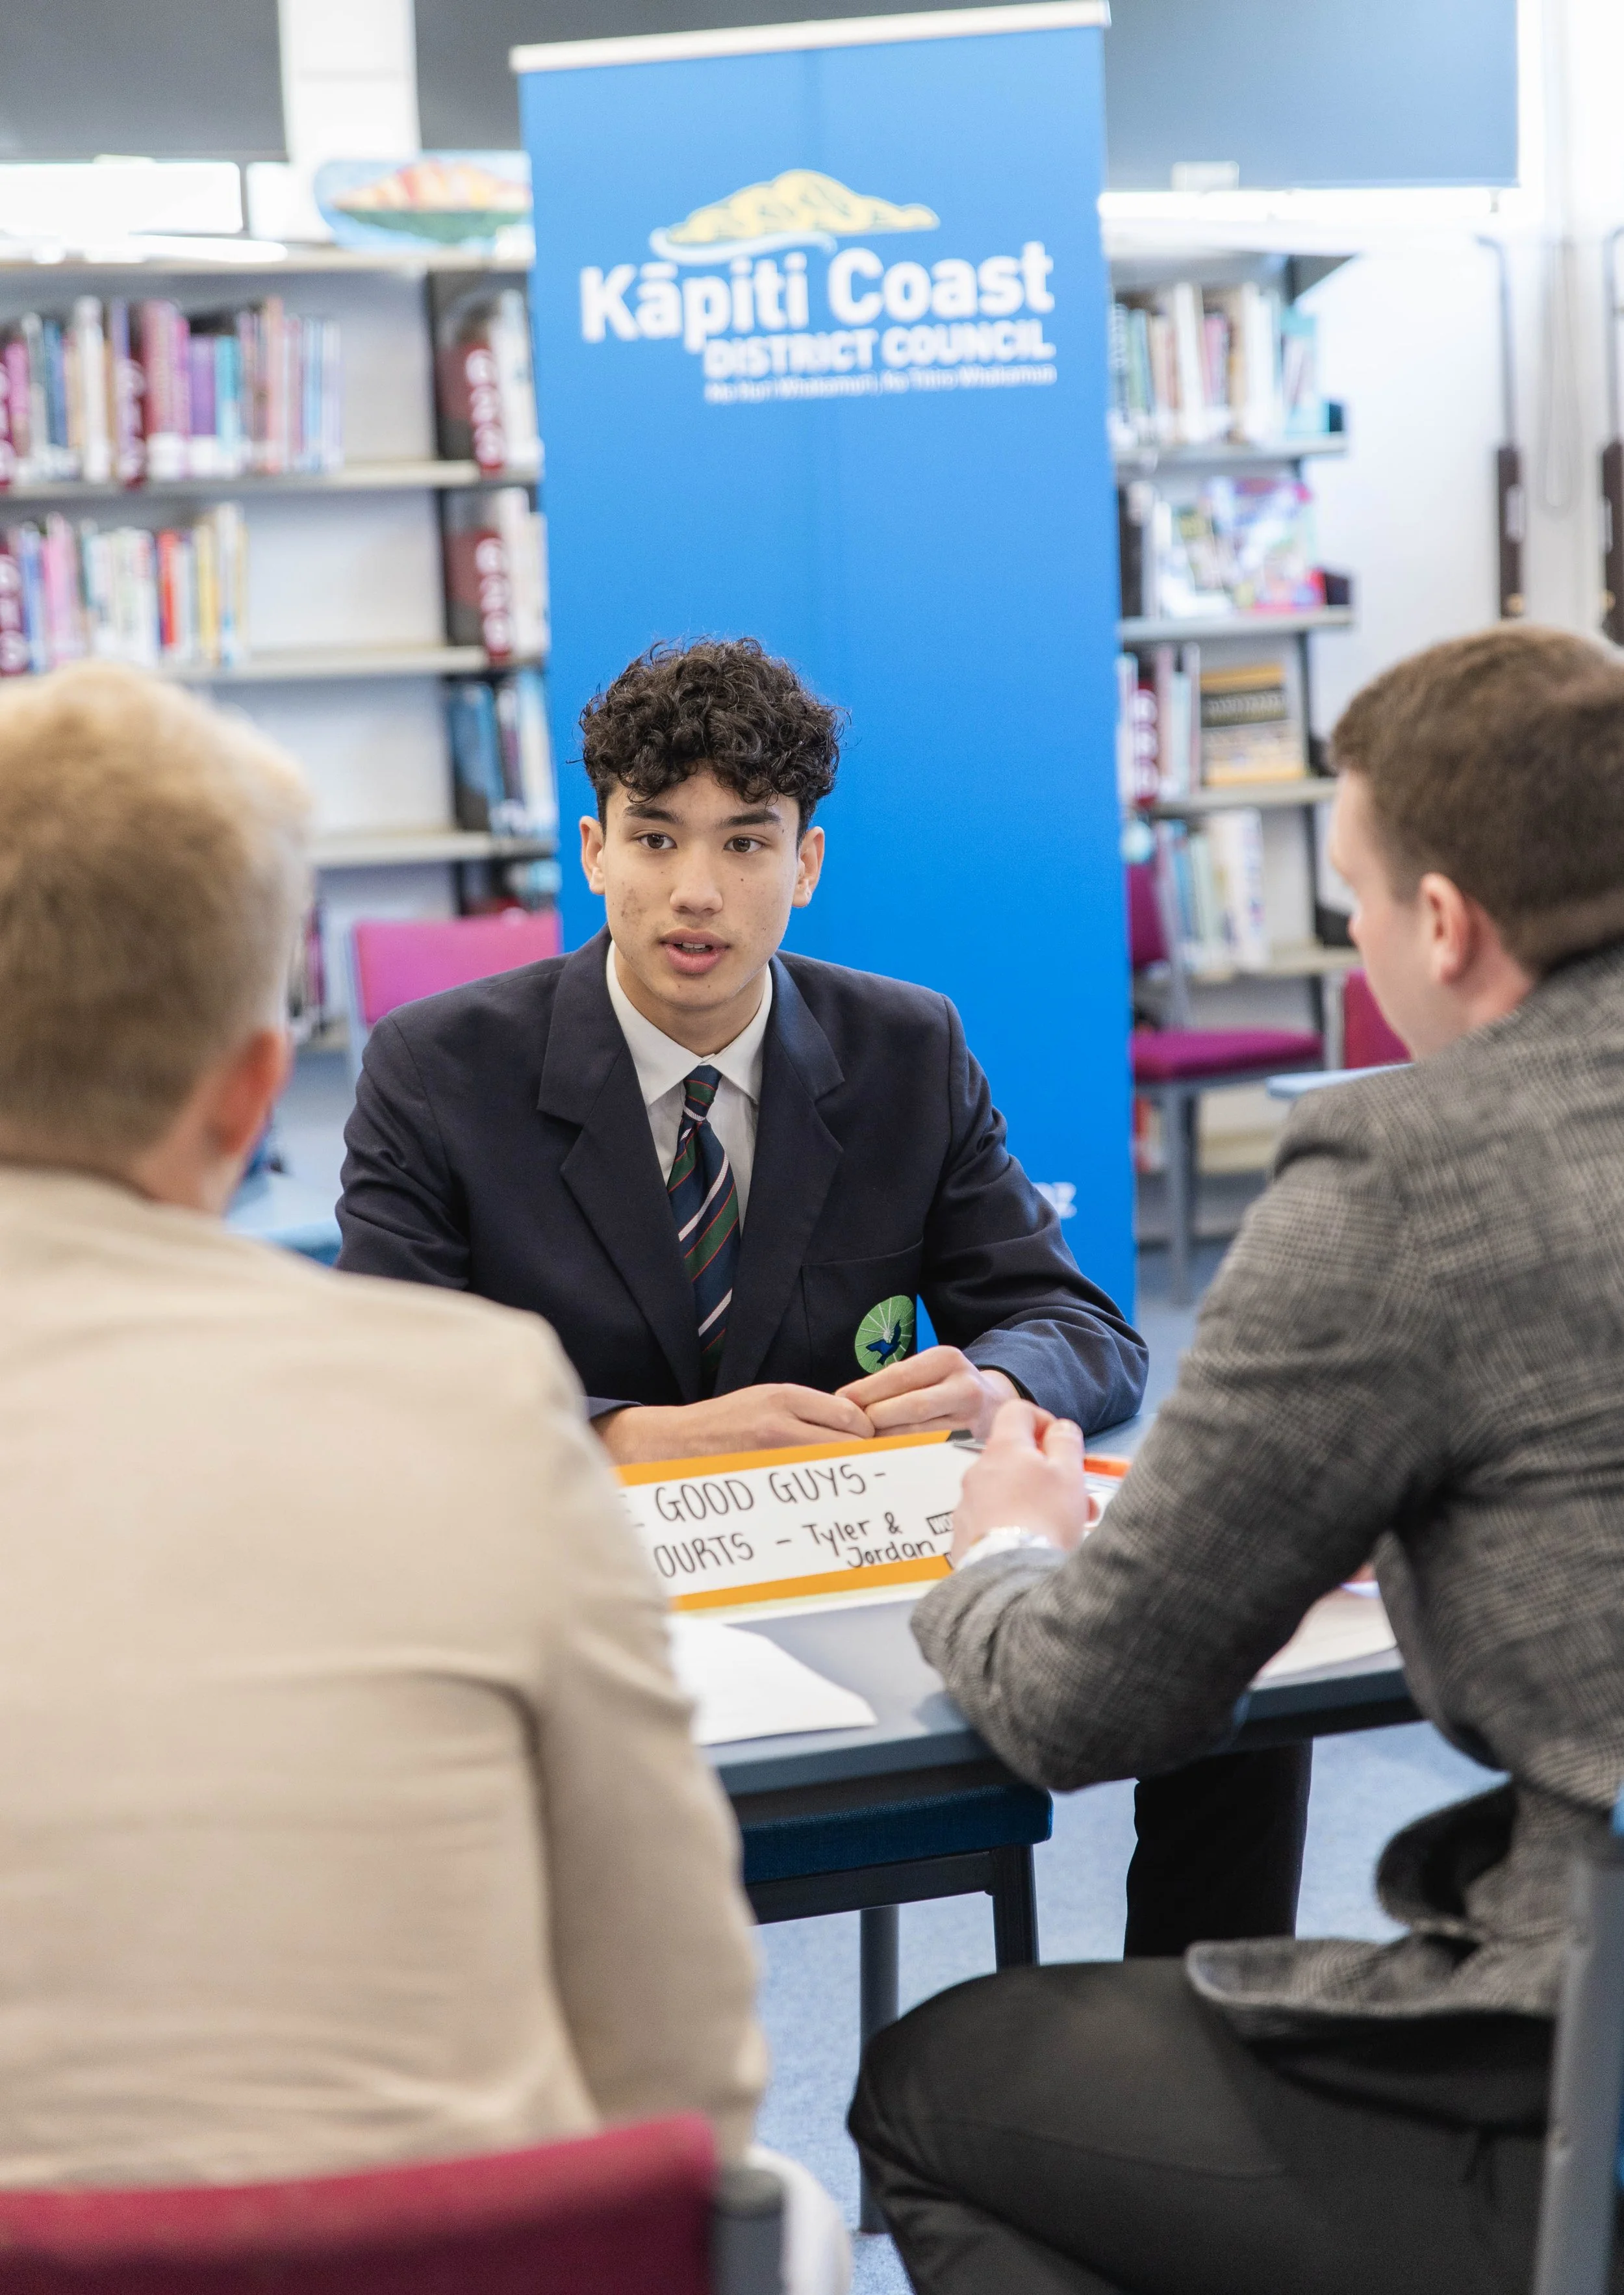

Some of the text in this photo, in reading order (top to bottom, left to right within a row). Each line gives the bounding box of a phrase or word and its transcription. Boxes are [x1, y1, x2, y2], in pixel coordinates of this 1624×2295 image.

[580, 242, 1056, 351] Kāpiti Coast
[704, 329, 880, 379] DISTRICT
[881, 319, 1056, 367] COUNCIL
[655, 1478, 754, 1522] GOOD
[768, 1463, 867, 1504] GUYS
[653, 1532, 755, 1578] OURTS
[801, 1519, 870, 1558] Tyler
[883, 1511, 902, 1535] &
[846, 1539, 935, 1569] Jordan
